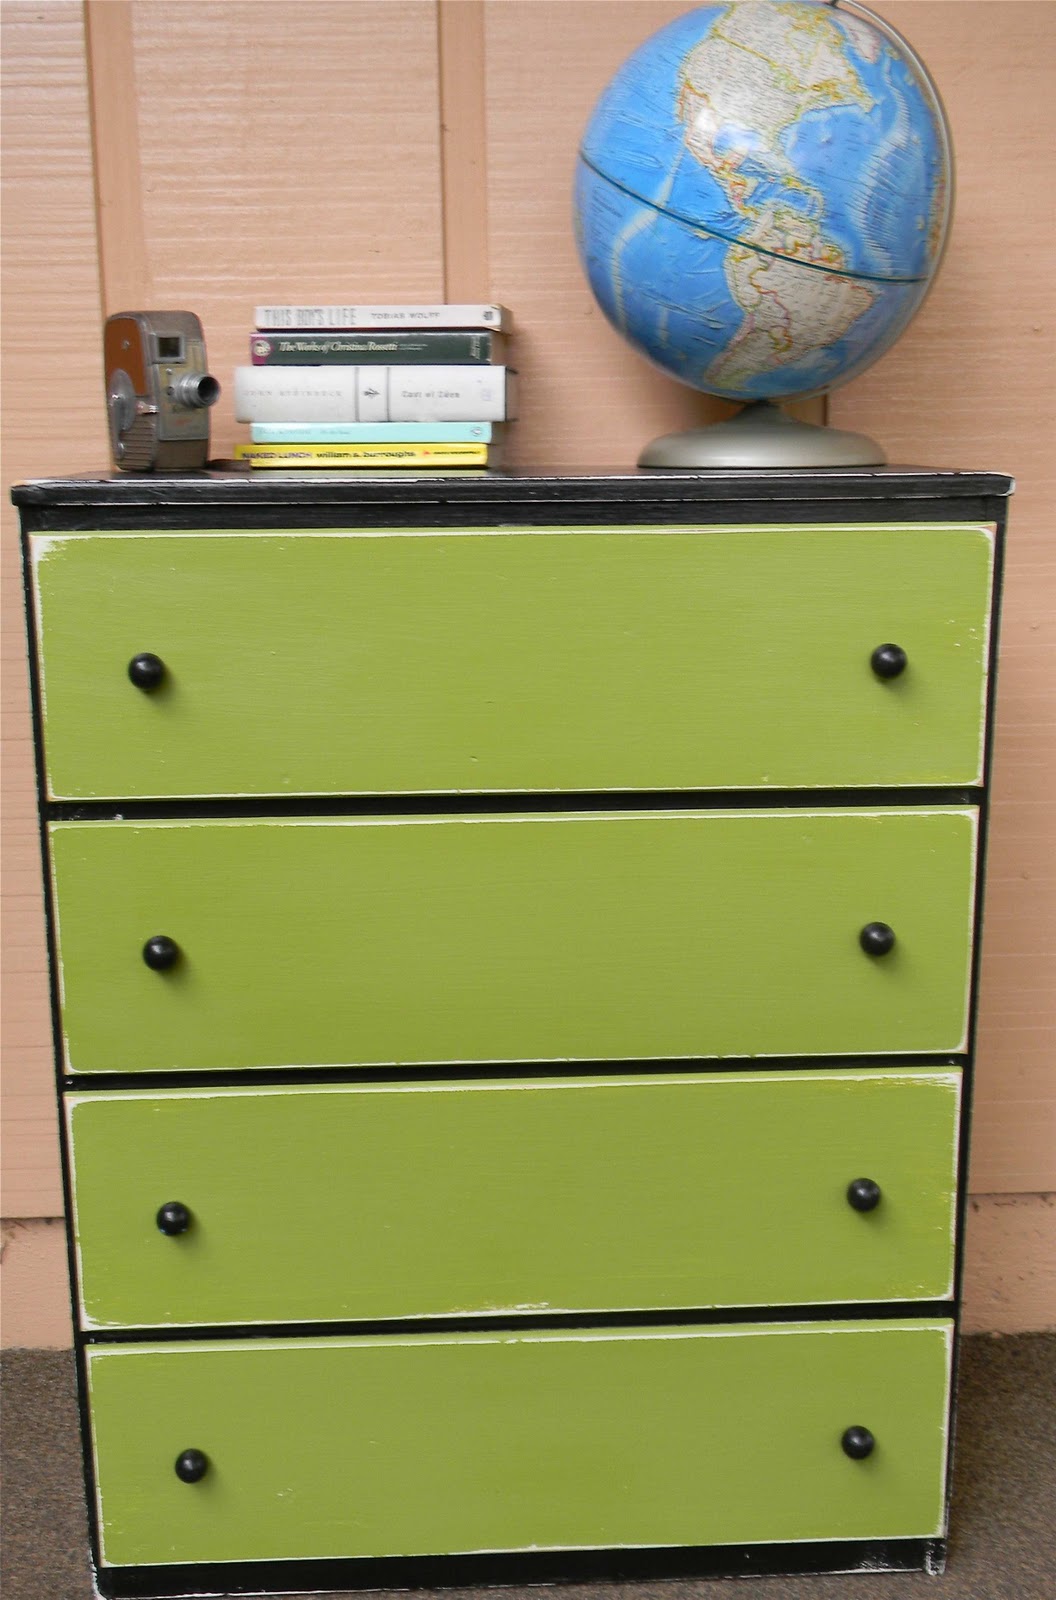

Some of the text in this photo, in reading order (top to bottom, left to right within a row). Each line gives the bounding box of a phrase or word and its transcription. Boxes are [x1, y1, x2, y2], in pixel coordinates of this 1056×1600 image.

[264, 309, 291, 326] THIS
[328, 308, 356, 326] LIFE
[279, 341, 296, 352] The
